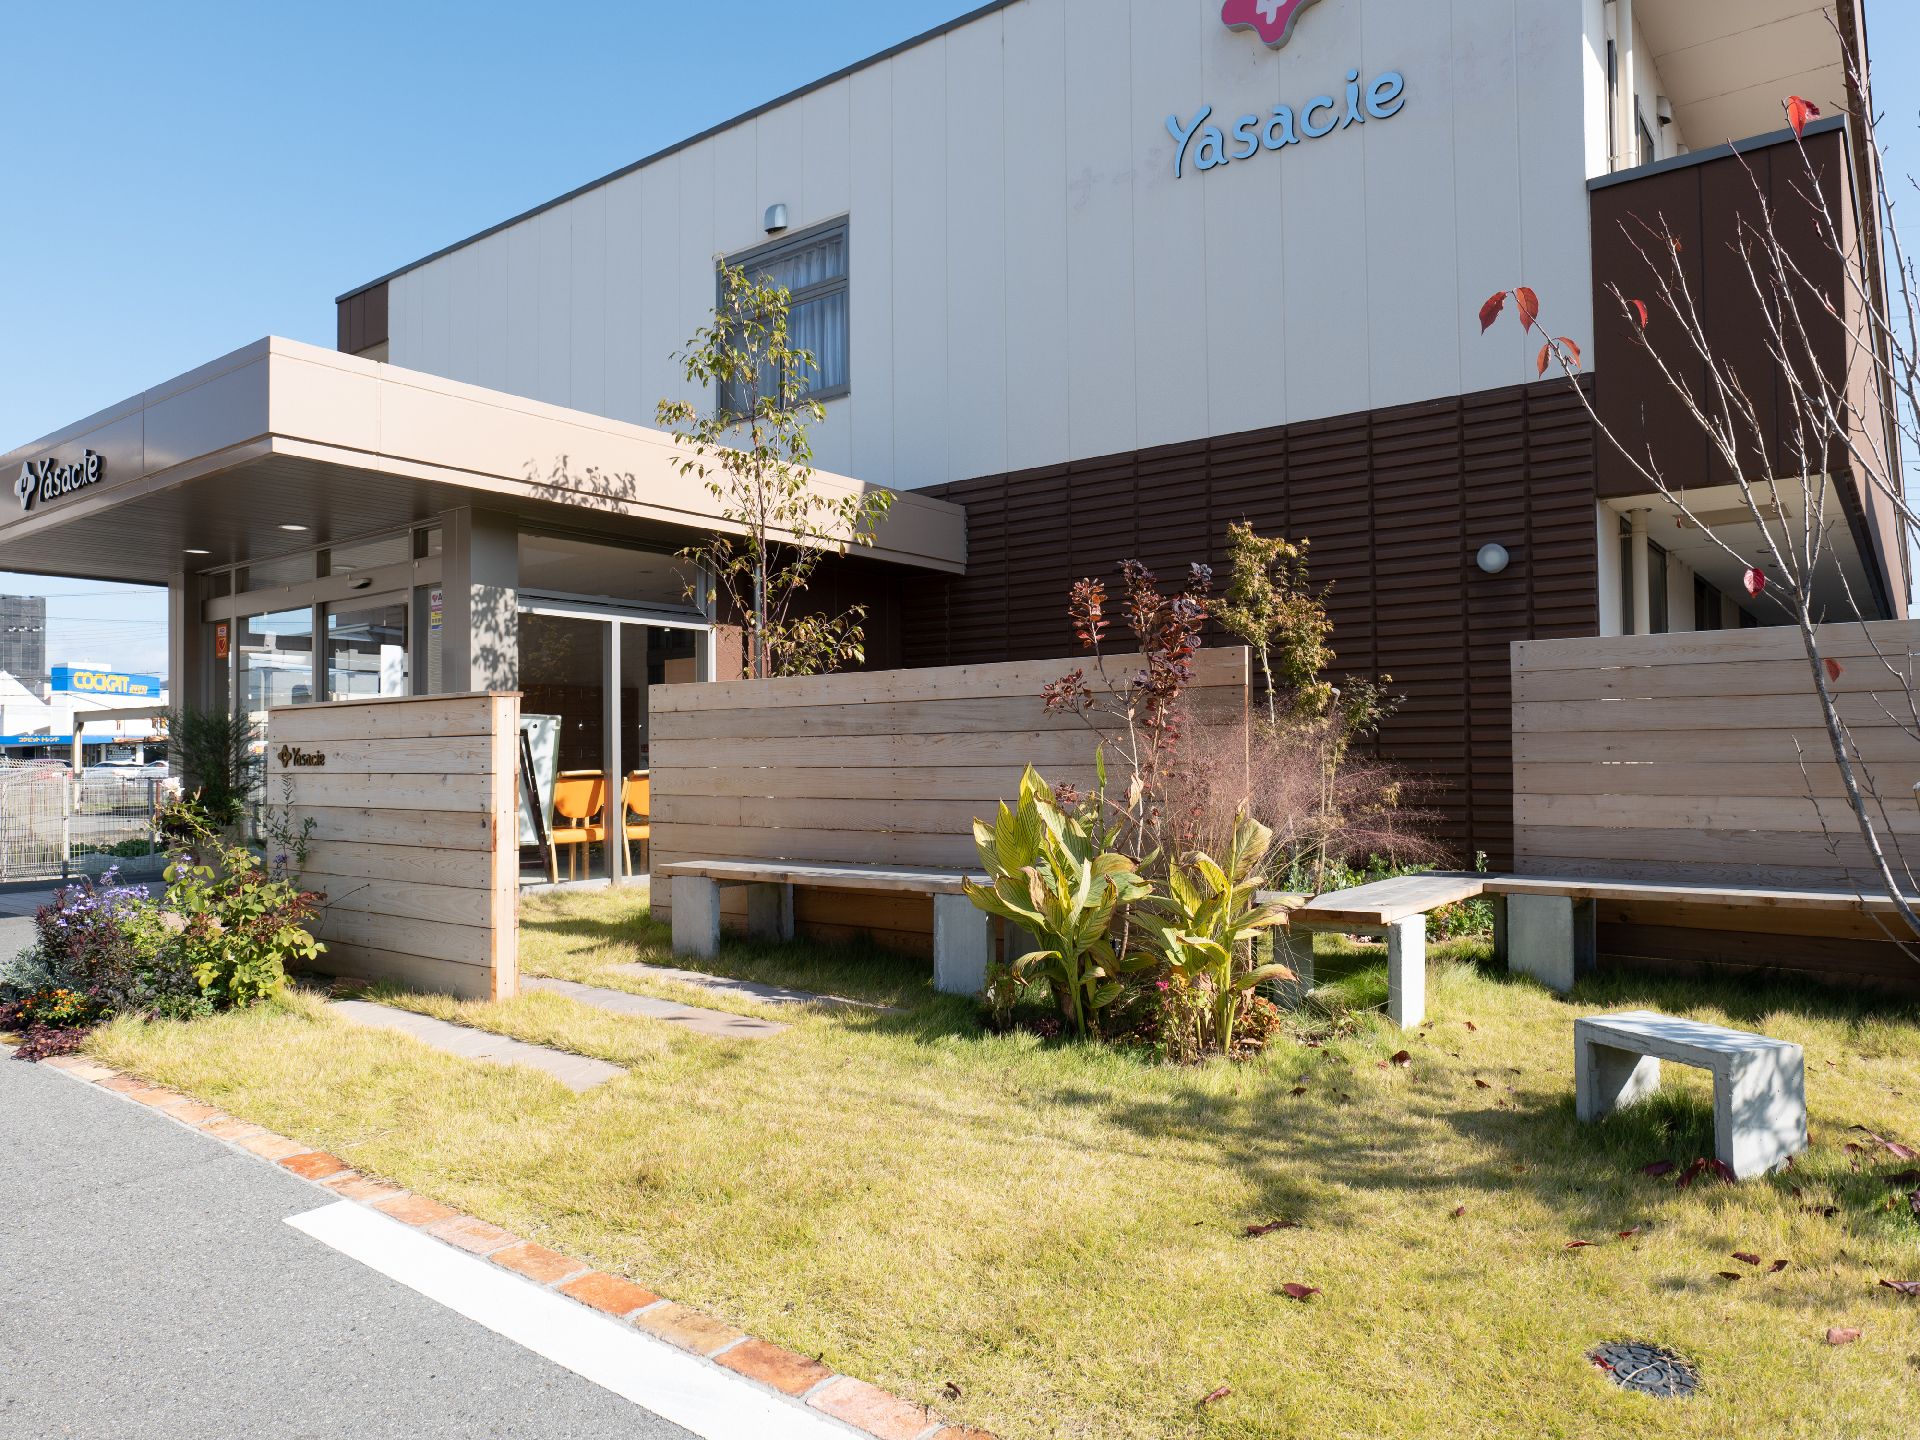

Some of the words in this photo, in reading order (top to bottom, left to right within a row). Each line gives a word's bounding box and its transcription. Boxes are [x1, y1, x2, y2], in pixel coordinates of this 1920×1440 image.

[1165, 69, 1406, 179] Yasacie
[37, 448, 101, 502] Yasacie
[73, 671, 130, 692] COCKPIT
[291, 747, 326, 767] Yasacie
